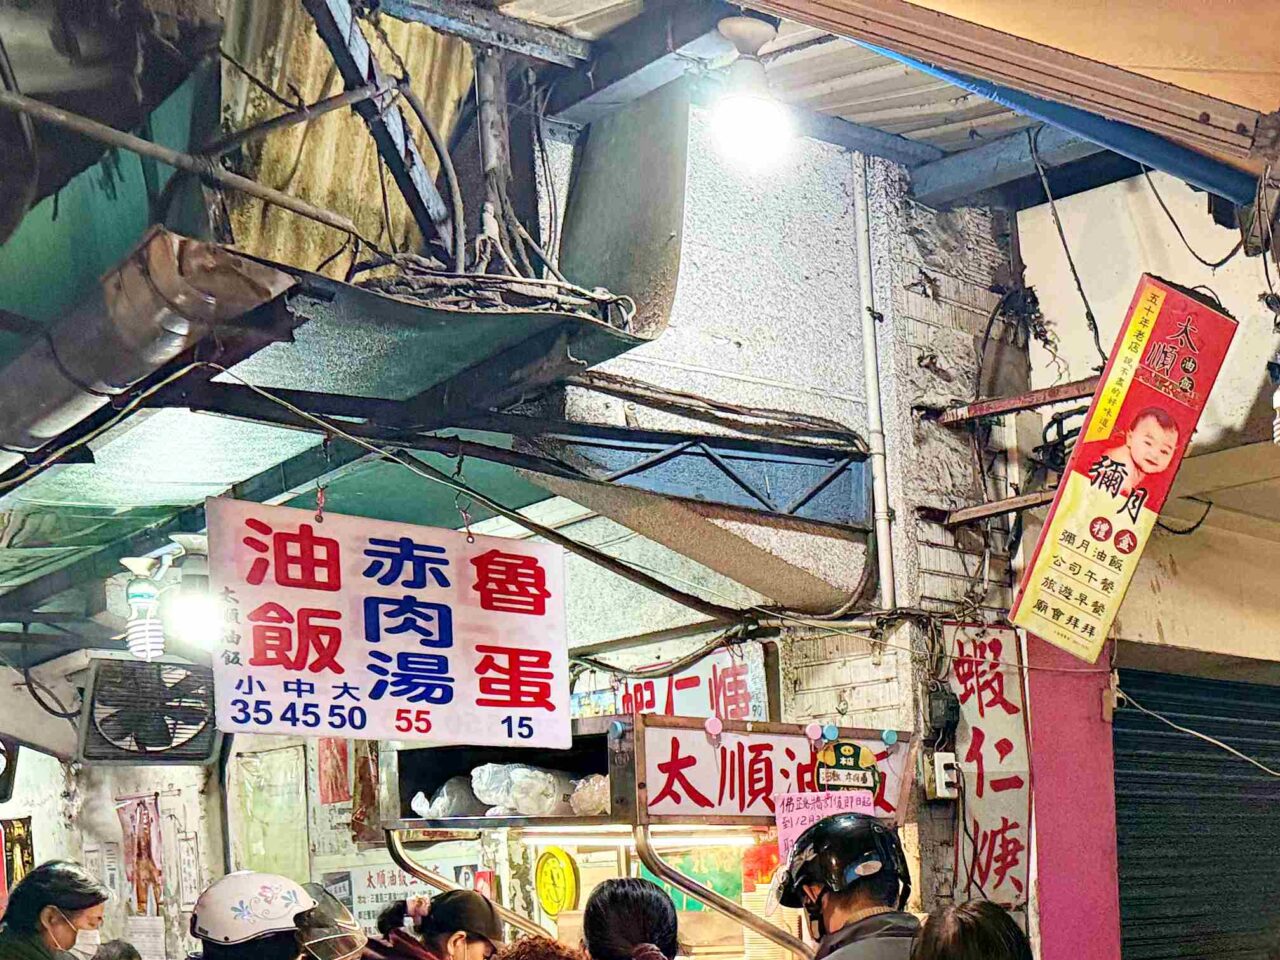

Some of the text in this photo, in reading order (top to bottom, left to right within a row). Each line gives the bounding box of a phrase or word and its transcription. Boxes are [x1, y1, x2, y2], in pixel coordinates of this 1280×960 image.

[1127, 292, 1162, 357] 五十年老店
[1089, 456, 1149, 526] 彌月
[1052, 553, 1116, 596] 公司午餐
[1060, 528, 1124, 573] 彌月油飯
[242, 518, 345, 675] 油飯
[362, 537, 455, 706] 赤肉湯
[1032, 599, 1097, 639] 廟會拜拜
[1041, 576, 1107, 618] 旅遊早餐
[469, 549, 557, 712] 魯蛋
[234, 675, 361, 702] 小 中 大
[230, 699, 535, 740] 35 45 50 55 15
[648, 735, 896, 814] 太順油
